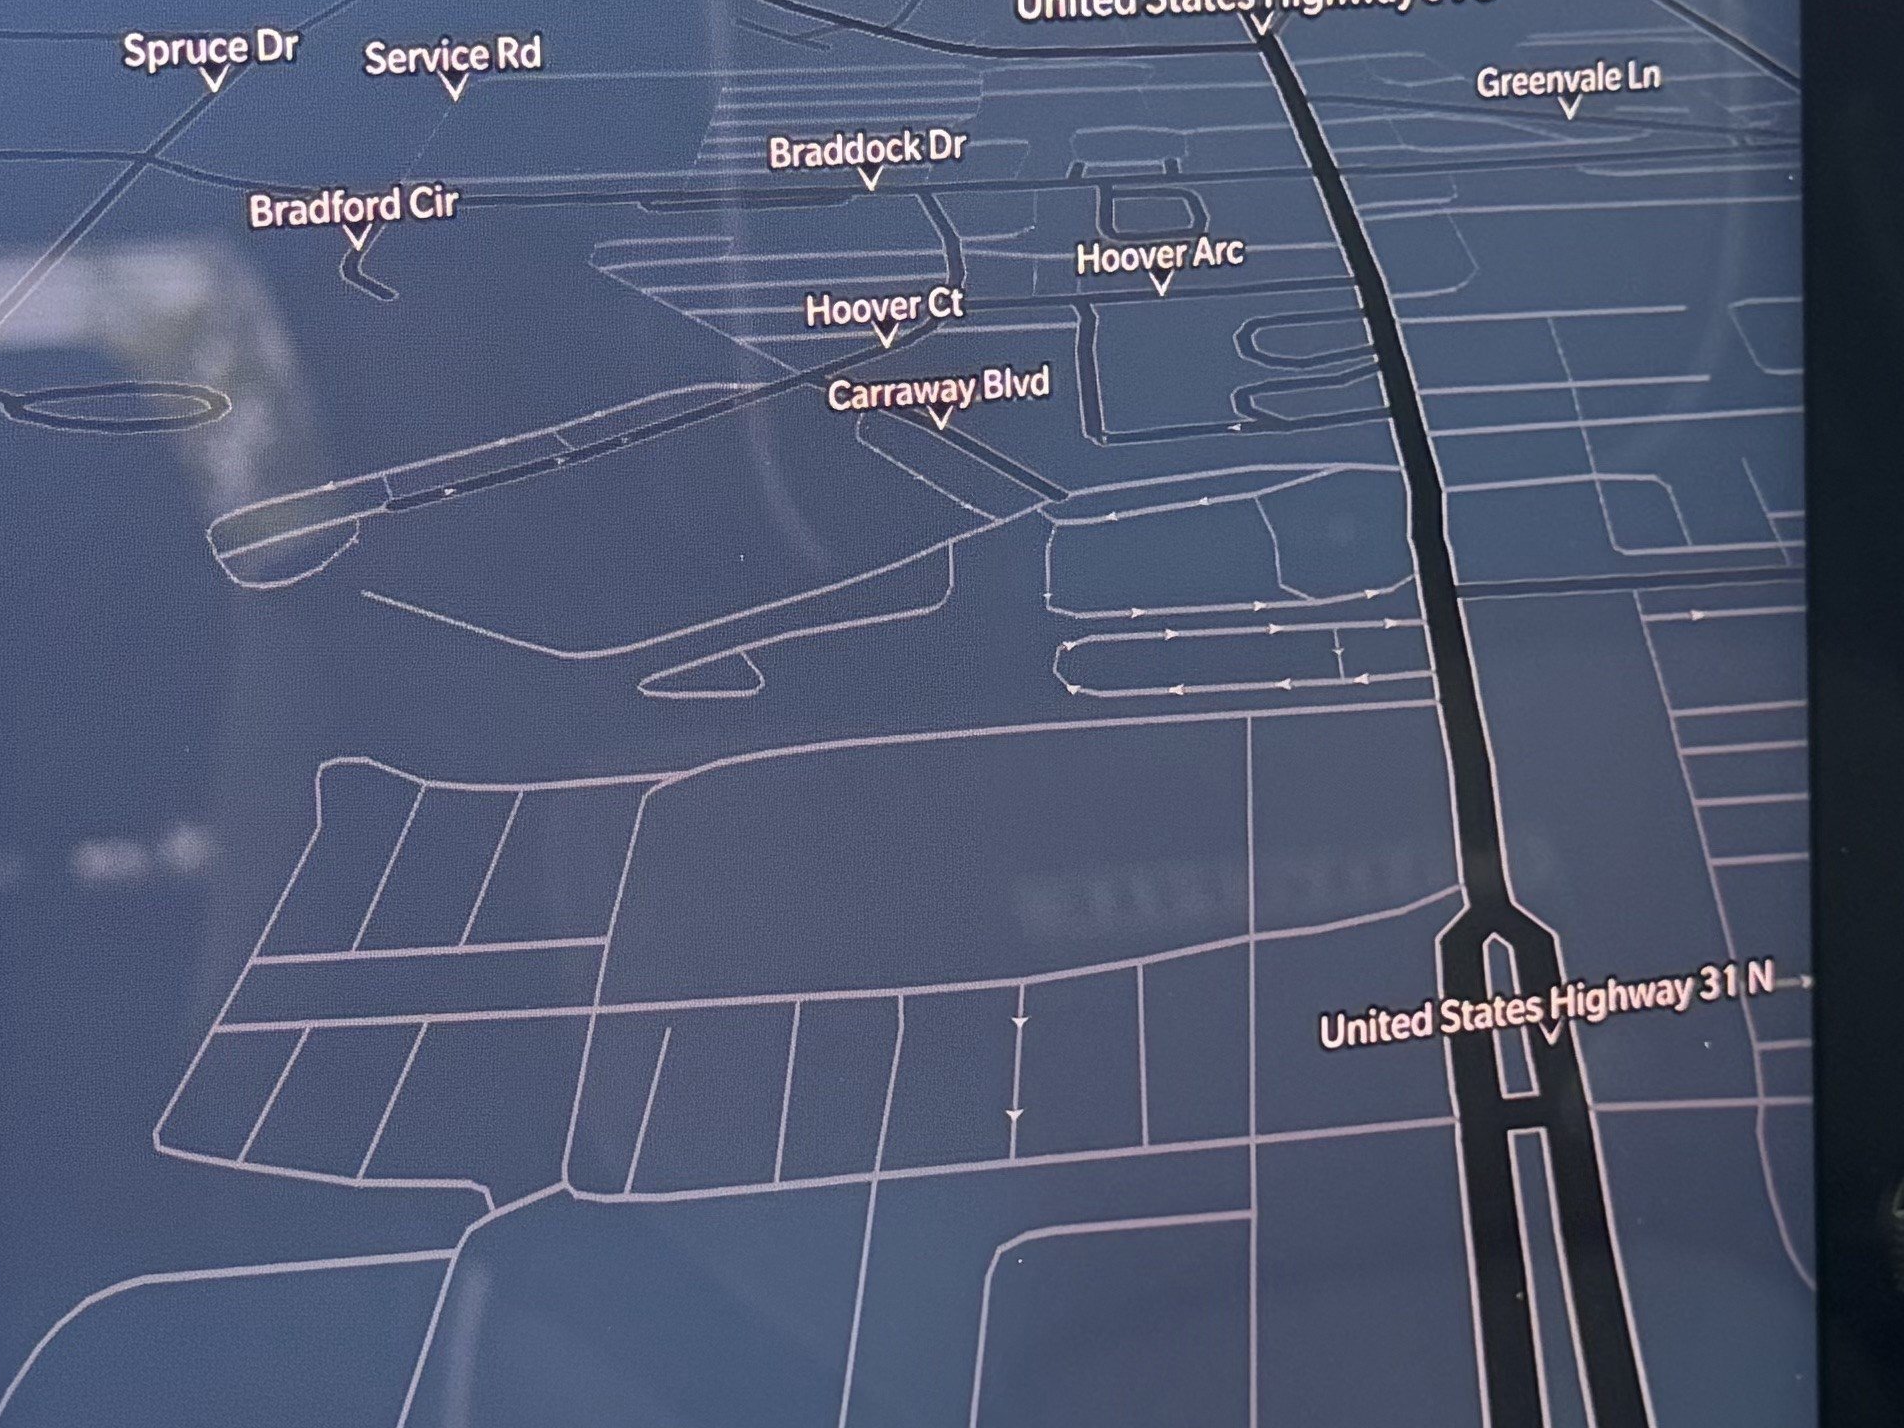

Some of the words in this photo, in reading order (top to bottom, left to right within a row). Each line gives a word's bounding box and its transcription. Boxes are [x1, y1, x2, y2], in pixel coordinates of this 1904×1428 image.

[123, 34, 248, 72] Spruce
[258, 31, 298, 64] Dr
[365, 39, 490, 75] Service
[498, 37, 541, 70] Rd
[1476, 64, 1619, 98] Greenvale
[1628, 61, 1660, 90] Ln
[769, 133, 921, 170] Braddock
[930, 131, 966, 161] Dr
[251, 192, 398, 229] Bradford
[408, 186, 458, 220] Cir
[1076, 241, 1187, 275] Hoover
[1194, 238, 1243, 267] Arc
[805, 292, 920, 326] Hoover
[929, 289, 963, 319] Ct
[827, 374, 976, 413] Carraway
[983, 365, 1050, 401] Blvd
[1321, 1000, 1434, 1049] United
[1440, 993, 1544, 1034] States
[1551, 976, 1694, 1023] Highway
[1700, 968, 1737, 1001] 31
[1747, 959, 1774, 993] N
